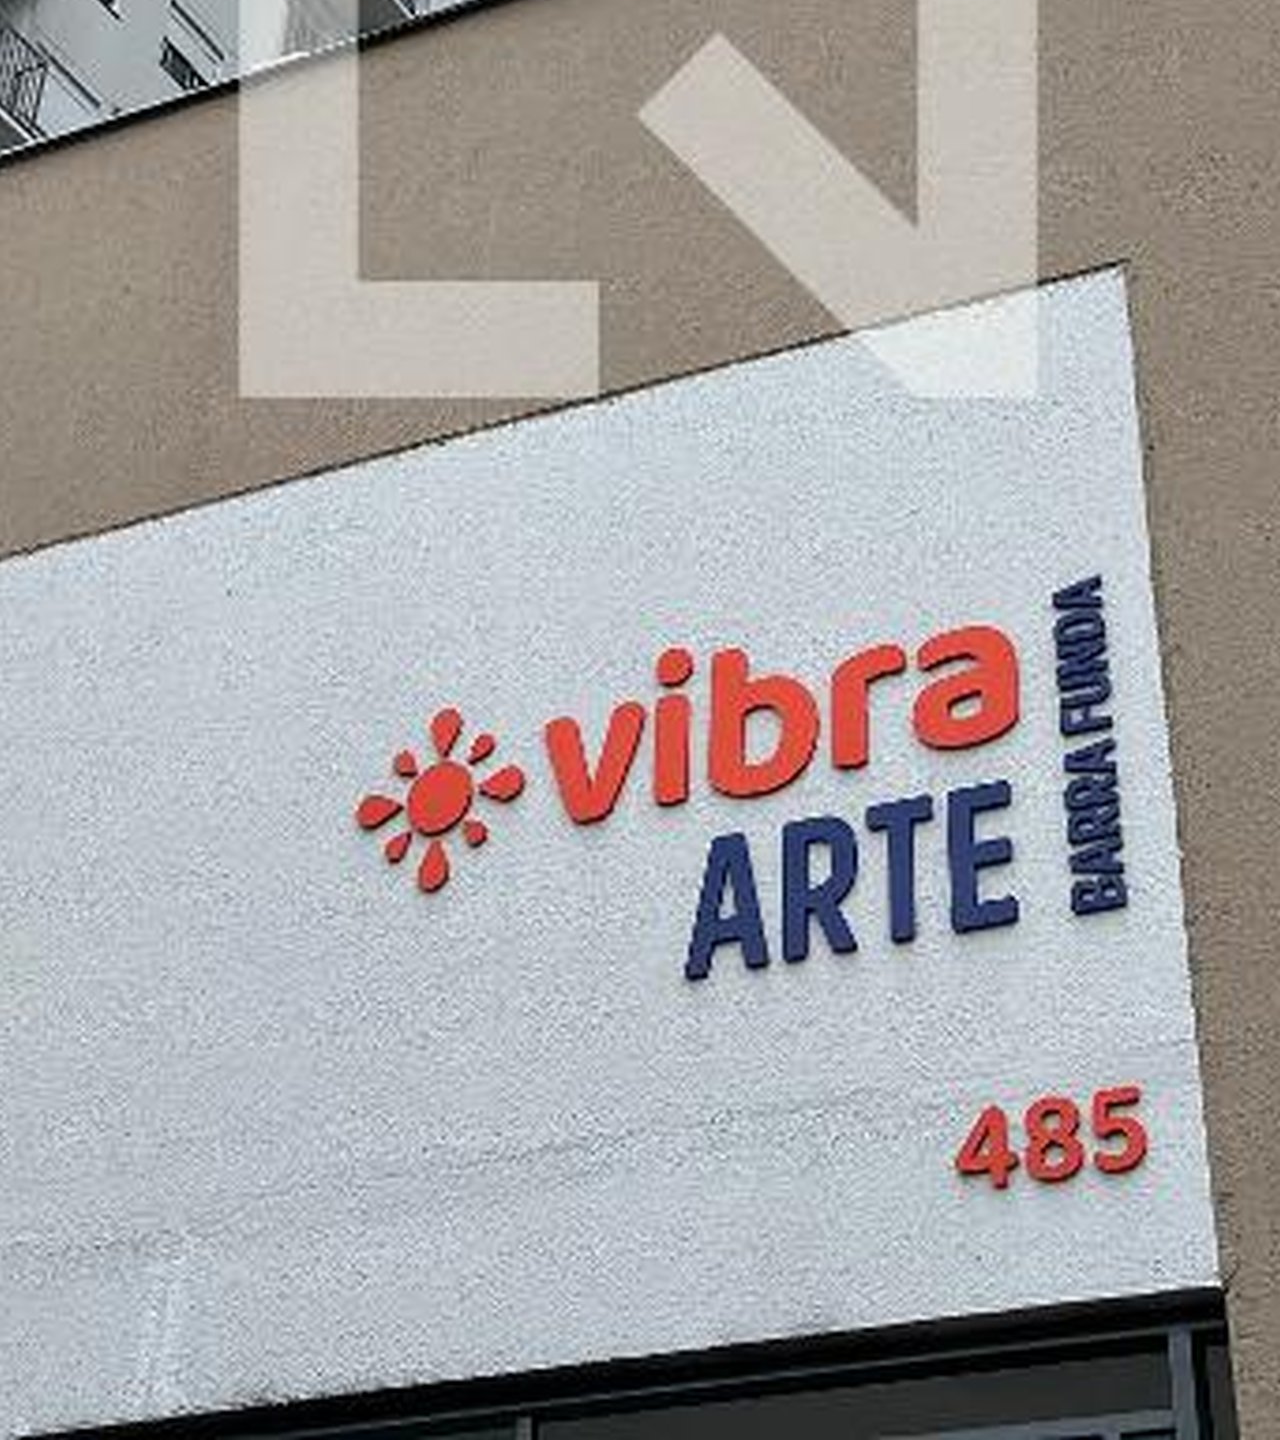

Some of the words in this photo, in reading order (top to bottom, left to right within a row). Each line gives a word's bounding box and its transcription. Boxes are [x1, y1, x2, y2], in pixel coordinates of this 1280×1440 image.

[544, 625, 1021, 825] vibra
[1052, 574, 1114, 737] FUNDA
[682, 779, 1021, 980] ARTE
[1062, 737, 1130, 917] BARRA
[954, 1085, 1150, 1188] 485
